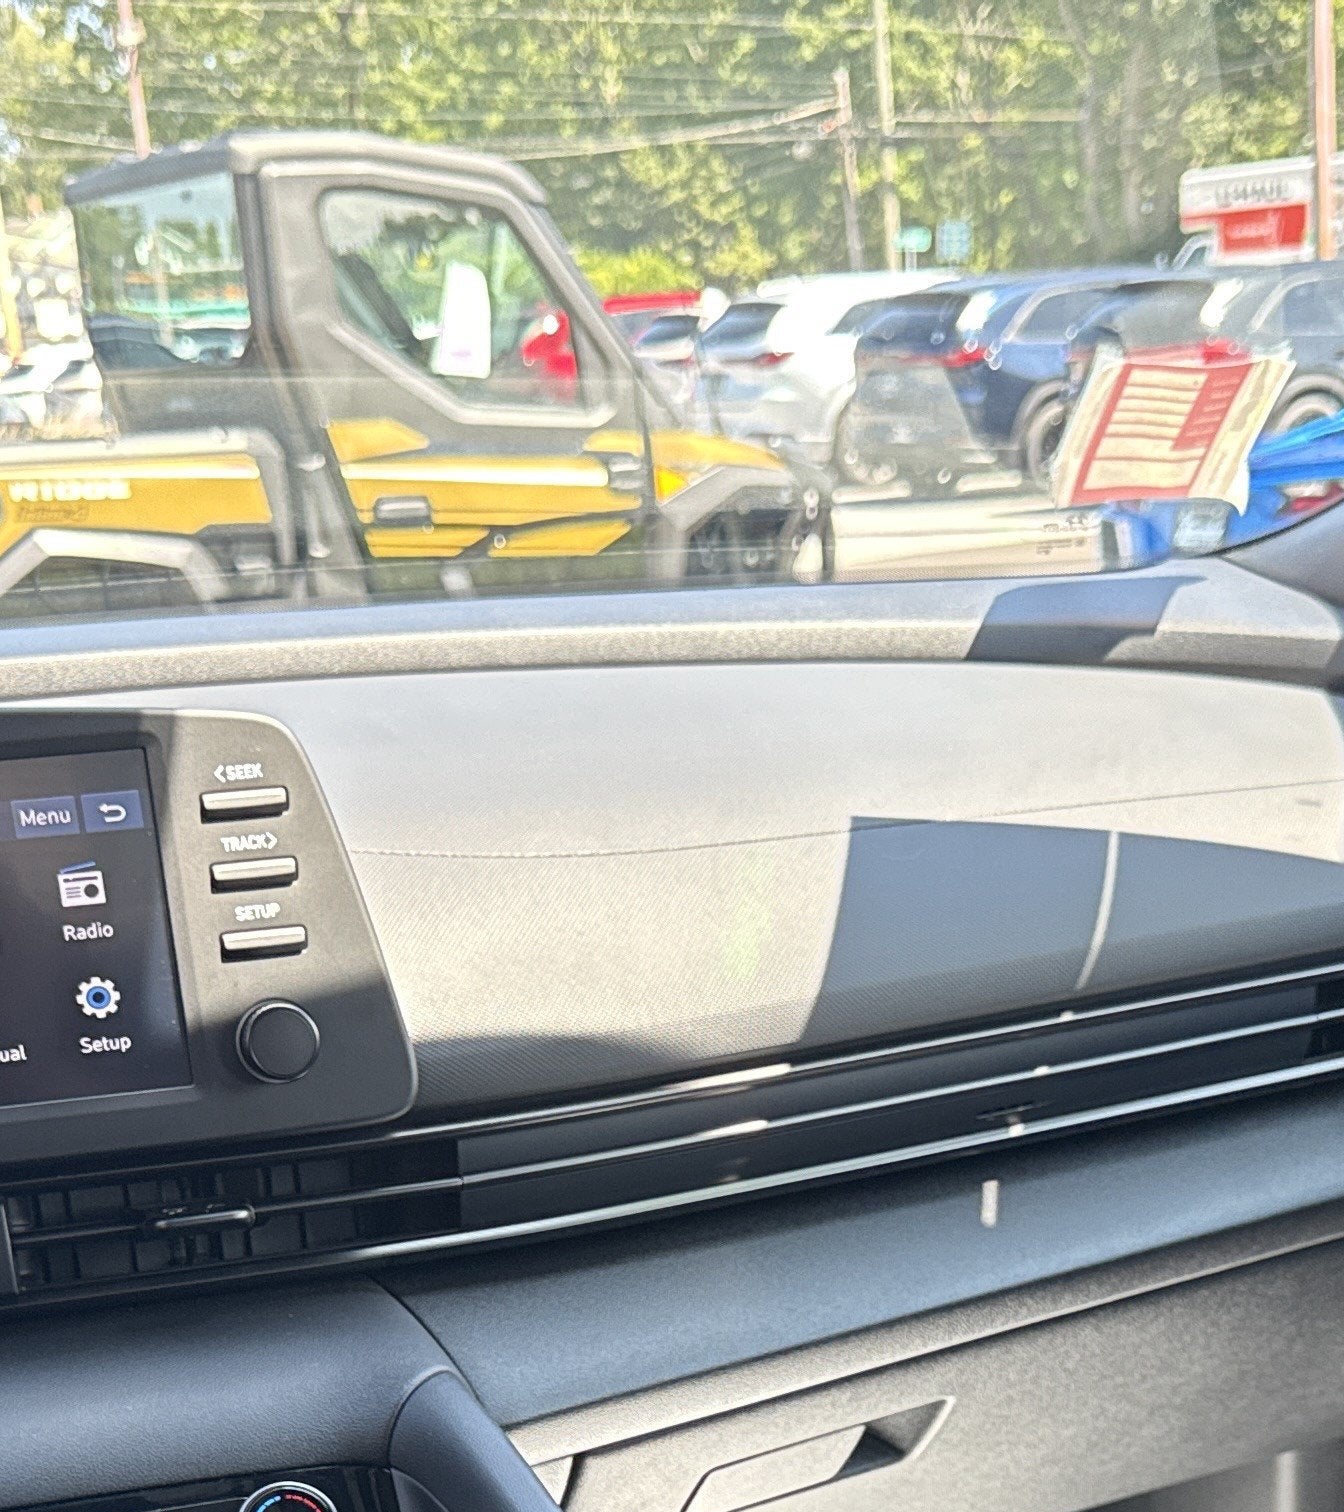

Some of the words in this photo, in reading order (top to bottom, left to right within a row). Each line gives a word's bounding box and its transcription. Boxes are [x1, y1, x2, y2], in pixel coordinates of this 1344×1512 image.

[225, 763, 264, 781] SEEK
[19, 809, 72, 827] Menu
[220, 833, 269, 852] TRACK
[234, 902, 281, 922] SETUP
[62, 921, 114, 942] Radio
[79, 1036, 133, 1054] Setup
